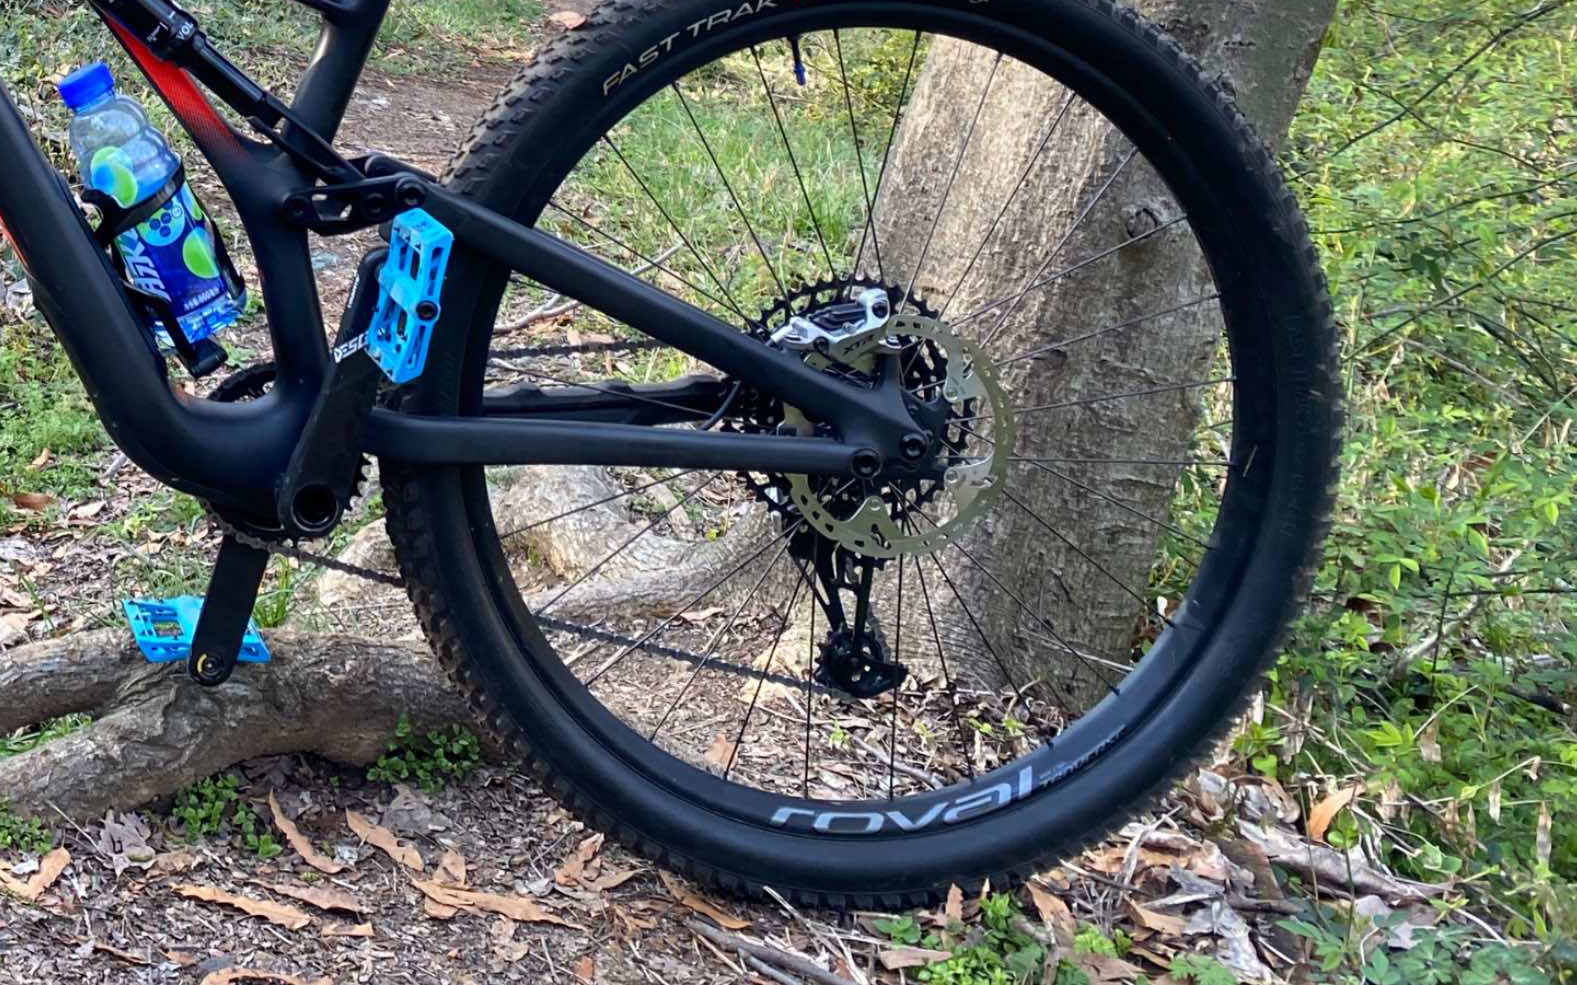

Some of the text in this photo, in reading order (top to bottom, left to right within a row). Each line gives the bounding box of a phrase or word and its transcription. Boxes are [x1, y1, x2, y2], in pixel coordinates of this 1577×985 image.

[602, 31, 681, 97] FAST
[333, 329, 369, 364] DESC
[769, 766, 1033, 835] roval
